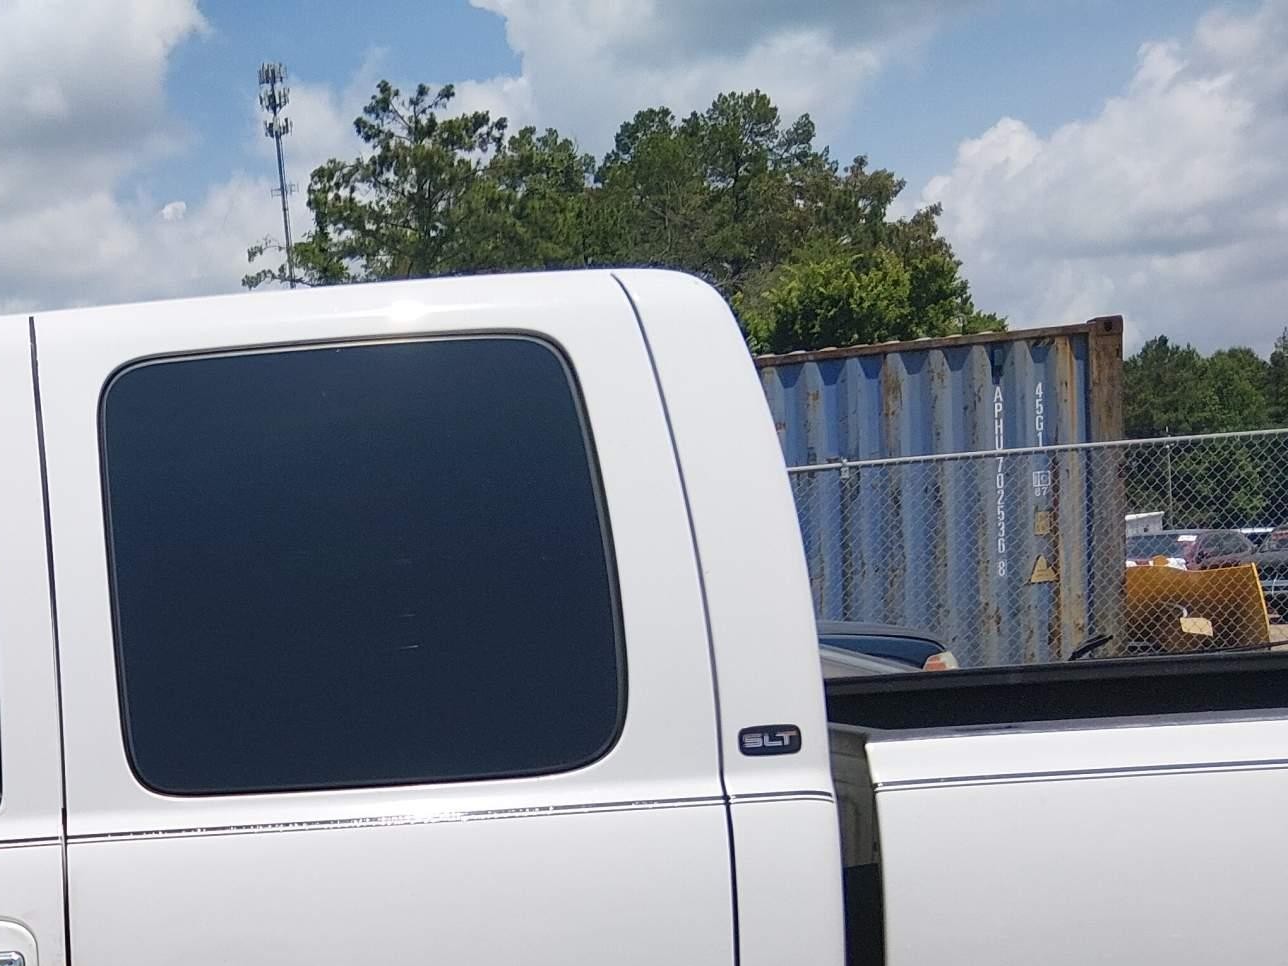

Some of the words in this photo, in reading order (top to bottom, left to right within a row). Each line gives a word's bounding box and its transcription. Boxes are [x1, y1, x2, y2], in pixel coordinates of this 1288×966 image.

[993, 386, 1004, 451] APHU
[1035, 381, 1044, 448] 45G1
[996, 456, 1006, 554] 702536
[998, 560, 1007, 577] 8
[743, 730, 797, 749] SLT
